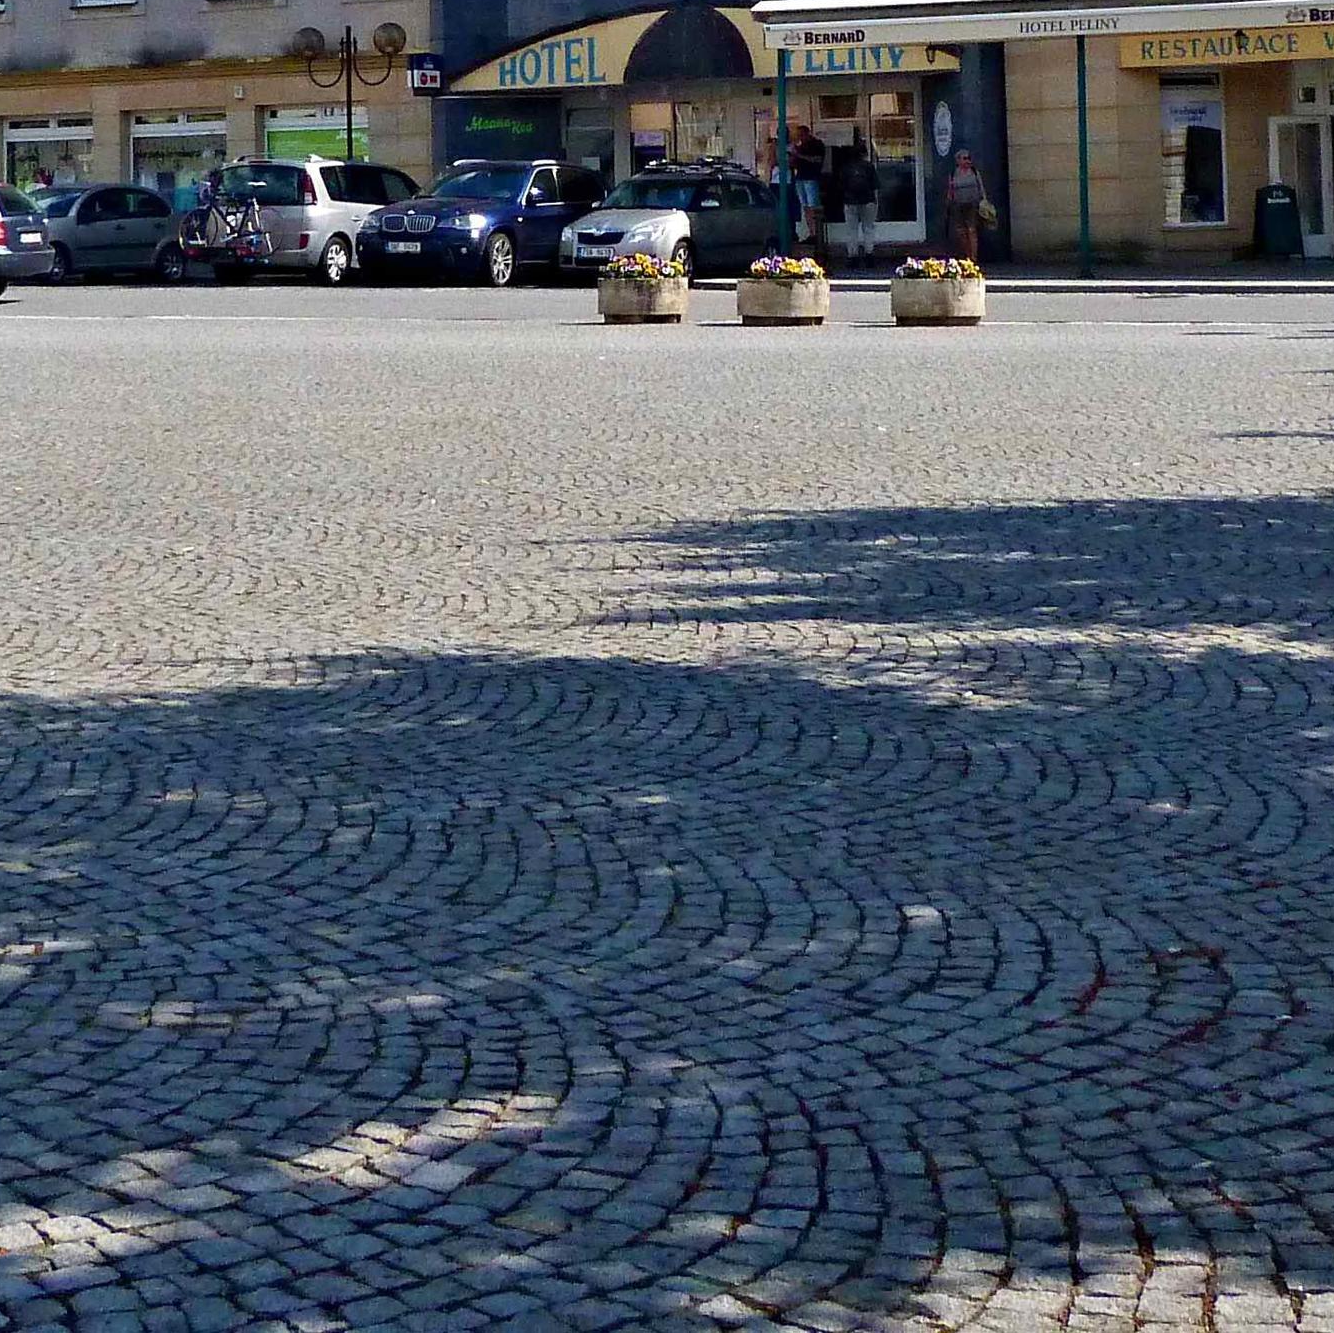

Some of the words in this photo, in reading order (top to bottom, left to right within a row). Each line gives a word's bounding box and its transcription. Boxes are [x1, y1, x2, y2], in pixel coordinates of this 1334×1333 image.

[1019, 19, 1066, 34] HOTEL
[1069, 17, 1120, 31] PELINY
[804, 29, 866, 45] BERNARD
[1141, 32, 1300, 60] RESTAURACE
[498, 36, 606, 87] HOTEL
